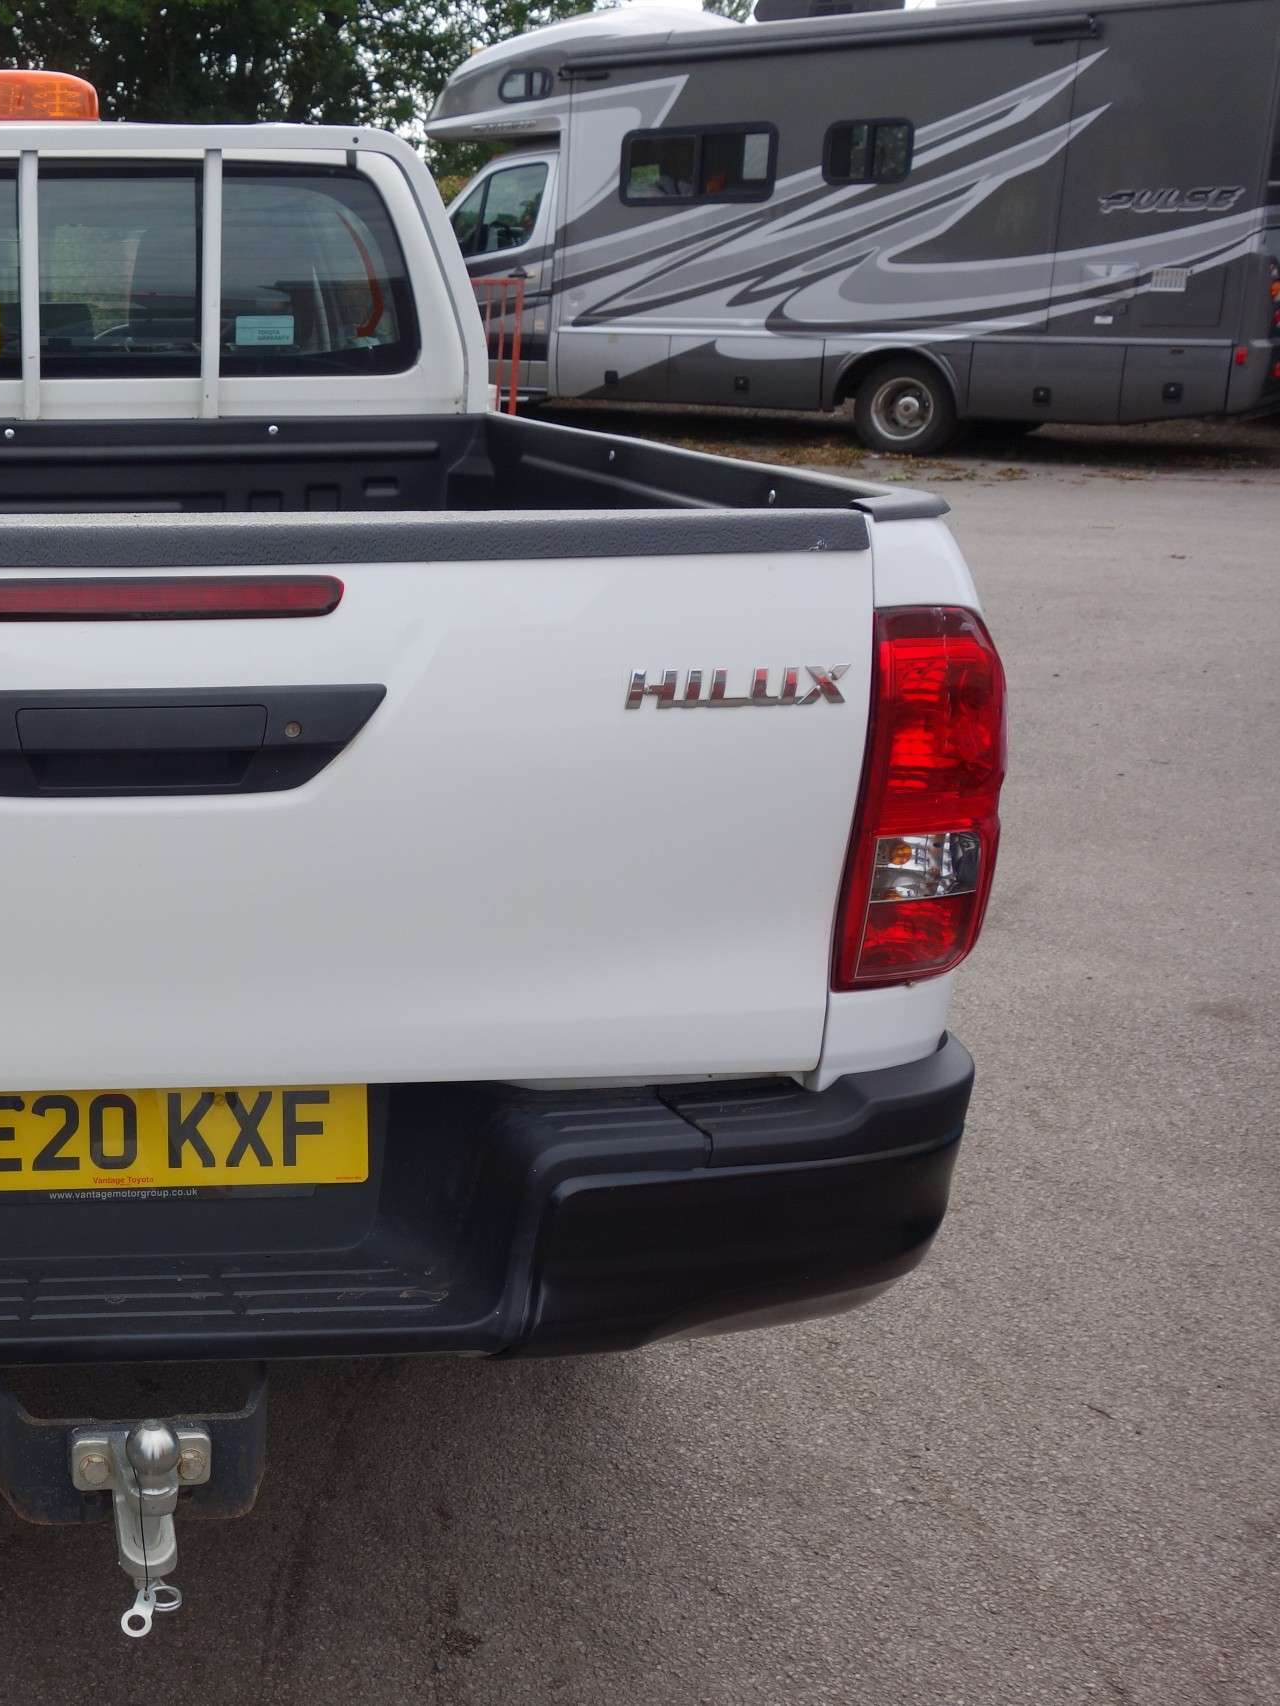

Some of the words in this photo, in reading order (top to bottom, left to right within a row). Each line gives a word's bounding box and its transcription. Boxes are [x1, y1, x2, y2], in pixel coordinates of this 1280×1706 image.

[1098, 185, 1246, 213] PULSE
[625, 664, 851, 709] HILUX
[167, 1091, 330, 1169] KXF
[49, 1187, 199, 1200] www.vantagemotorgroup.co.uk
[93, 1176, 124, 1186] Vantage
[128, 1176, 154, 1185] Toyota
